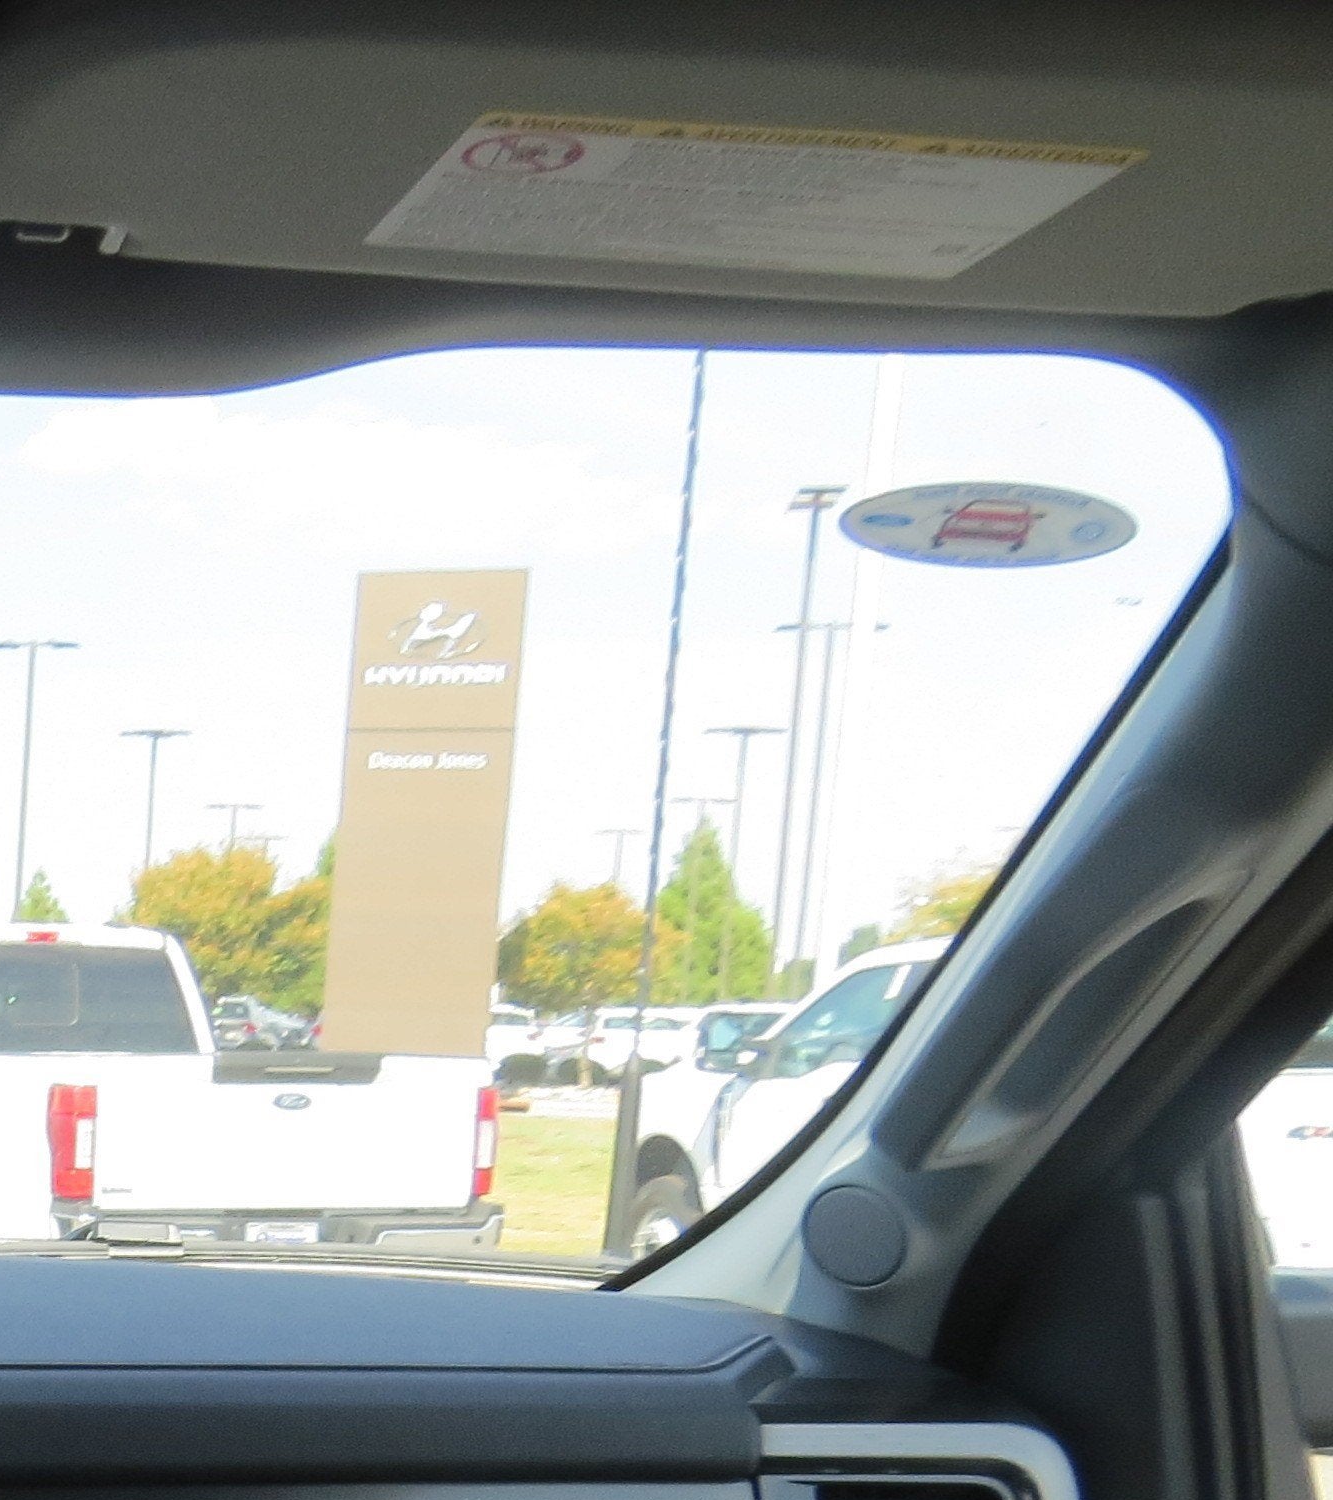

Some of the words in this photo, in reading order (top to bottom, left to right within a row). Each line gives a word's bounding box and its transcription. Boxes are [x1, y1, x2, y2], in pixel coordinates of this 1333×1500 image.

[364, 664, 507, 684] HYUNDAI
[368, 752, 433, 769] Deacon
[434, 752, 488, 769] Jones
